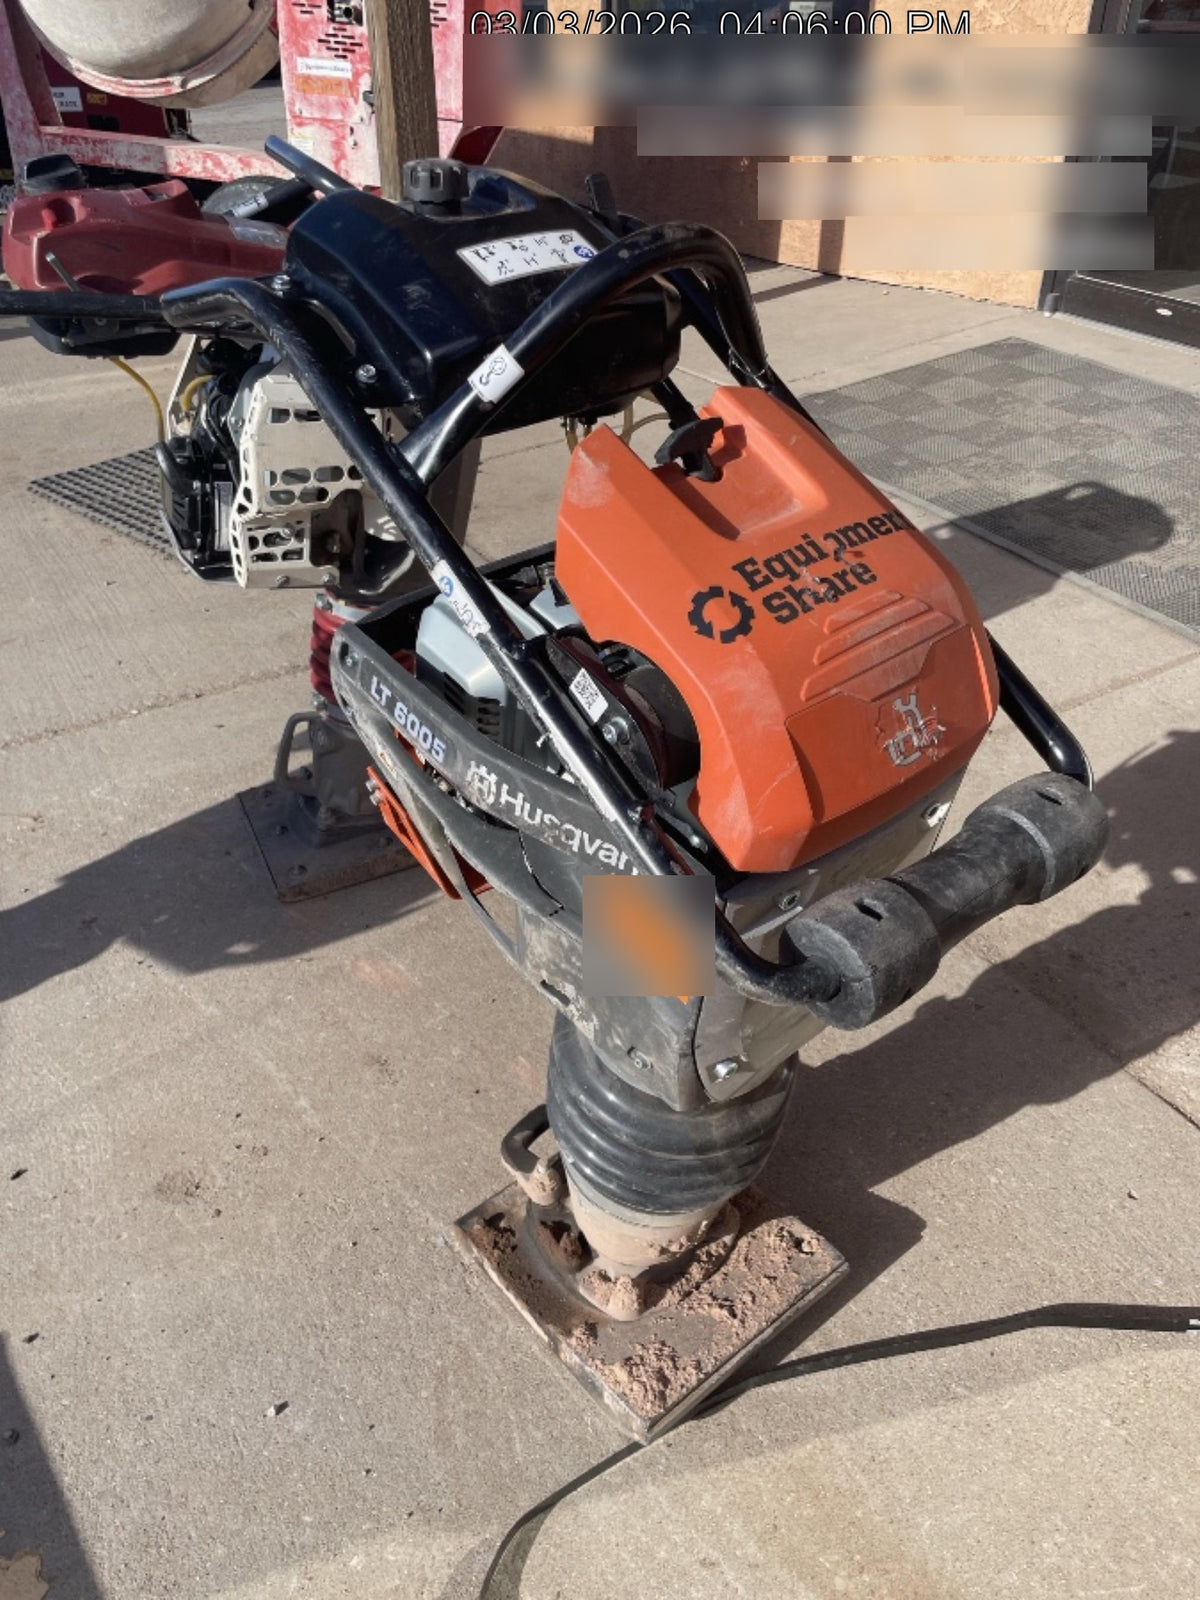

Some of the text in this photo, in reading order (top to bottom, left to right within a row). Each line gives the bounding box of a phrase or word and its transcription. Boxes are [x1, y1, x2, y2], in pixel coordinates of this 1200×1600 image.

[762, 562, 878, 625] Share
[371, 675, 447, 763] LT 6005
[499, 783, 640, 876] Husqvar
